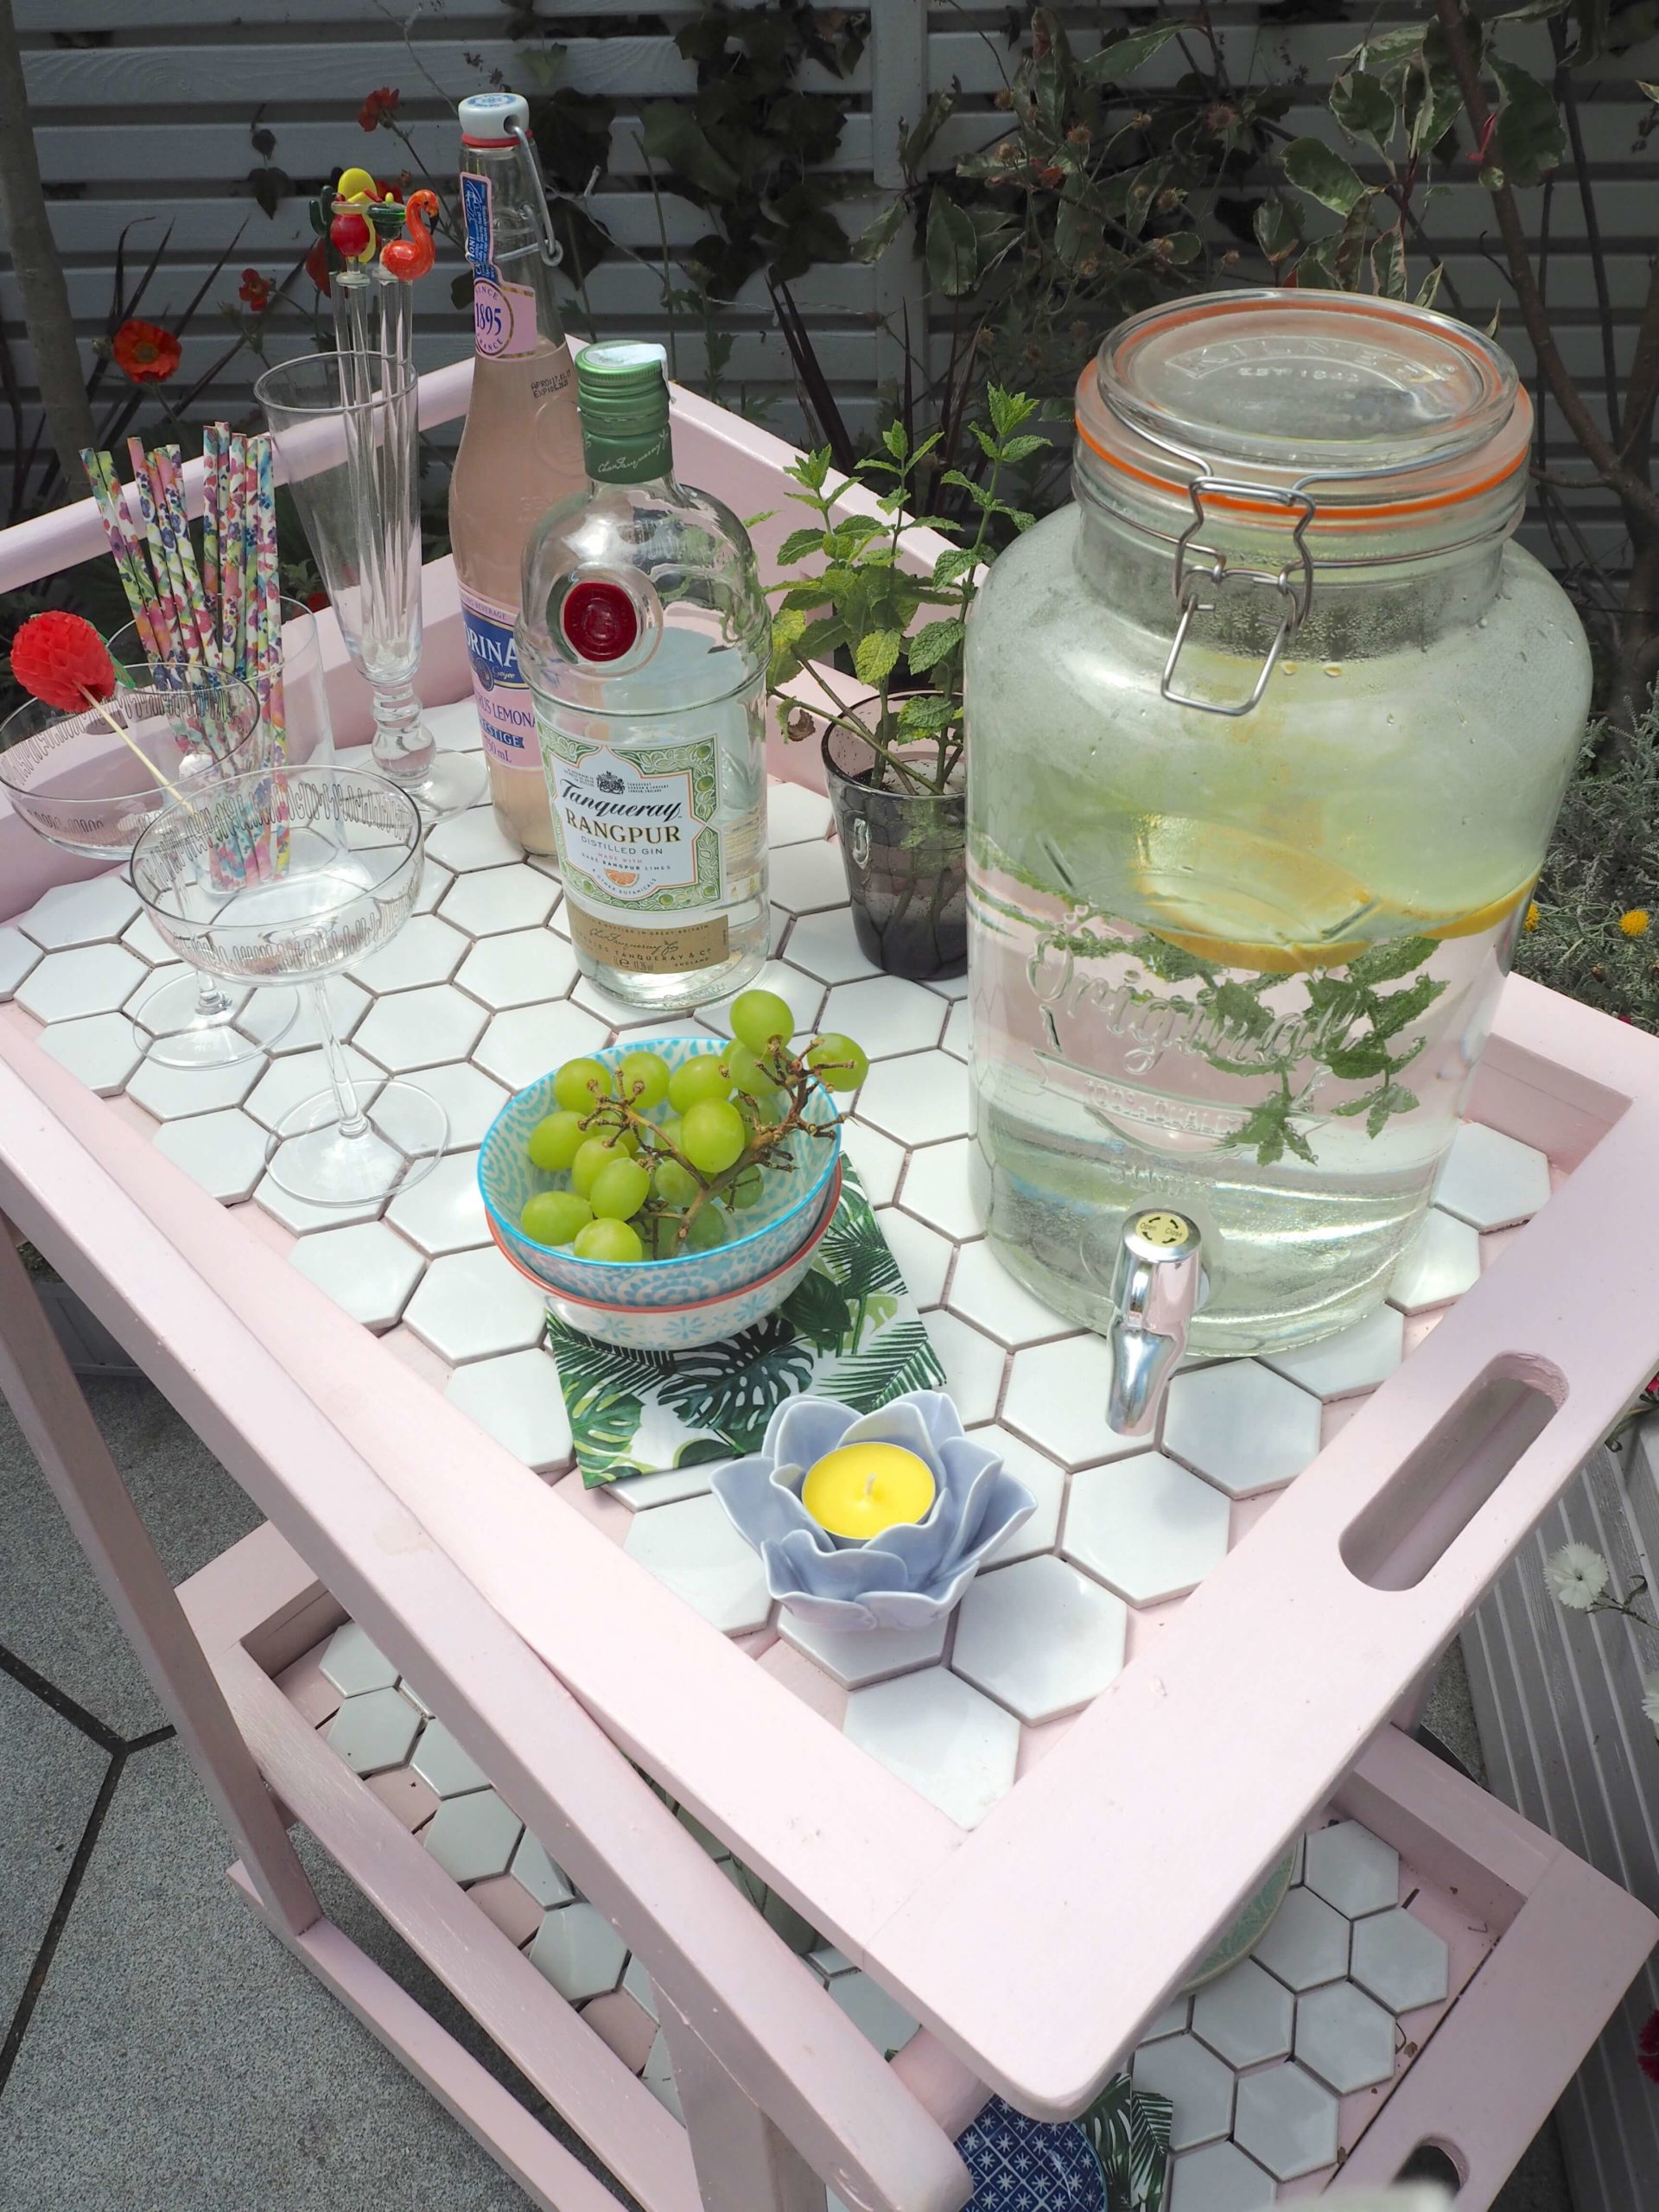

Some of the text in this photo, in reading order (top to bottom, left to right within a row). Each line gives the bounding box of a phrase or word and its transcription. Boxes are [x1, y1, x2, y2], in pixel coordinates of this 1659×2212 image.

[469, 236, 482, 275] CAION!
[476, 302, 502, 336] 1895
[474, 601, 508, 620] BEVERAGE
[463, 620, 518, 668] ORINA
[493, 702, 535, 728] LEMON
[560, 779, 681, 823] Tanqueray
[565, 808, 681, 843] RANGPUR
[581, 836, 637, 855] DISTILLED
[678, 925, 709, 934] BRITAIN
[614, 950, 683, 962] TANQUERAY
[1026, 931, 1363, 1074] Original
[1154, 1099, 1244, 1136] QUALIT
[1140, 1222, 1183, 1237] Open Close
